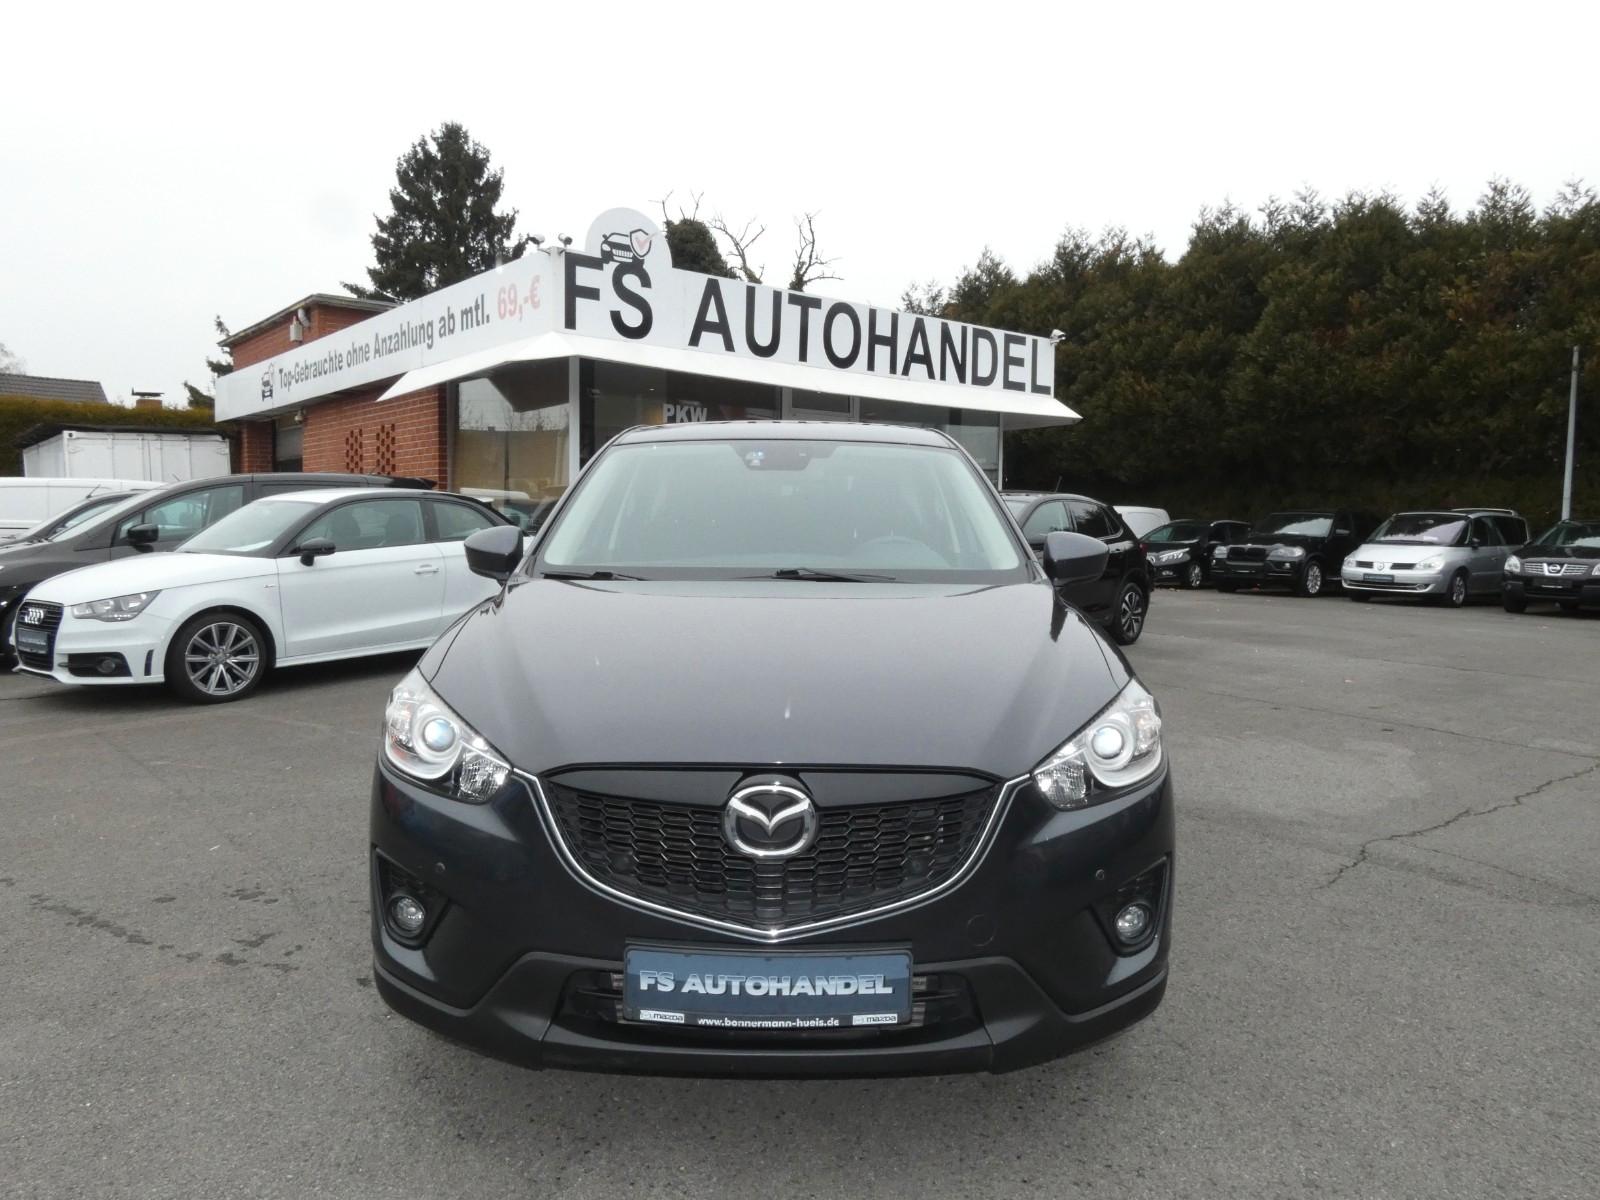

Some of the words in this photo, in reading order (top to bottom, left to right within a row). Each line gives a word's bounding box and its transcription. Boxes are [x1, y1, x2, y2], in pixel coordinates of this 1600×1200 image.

[278, 350, 344, 392] Top-Gebrauchte
[346, 341, 370, 369] ohne
[373, 320, 434, 359] Anzahlung
[438, 306, 456, 338] ab
[460, 293, 490, 331] mtl.
[564, 252, 654, 340] FS
[688, 277, 1053, 395] AUTOHANDEL
[662, 403, 708, 424] PKW
[639, 970, 676, 992] FS
[680, 974, 895, 997] AUTOHANDEL
